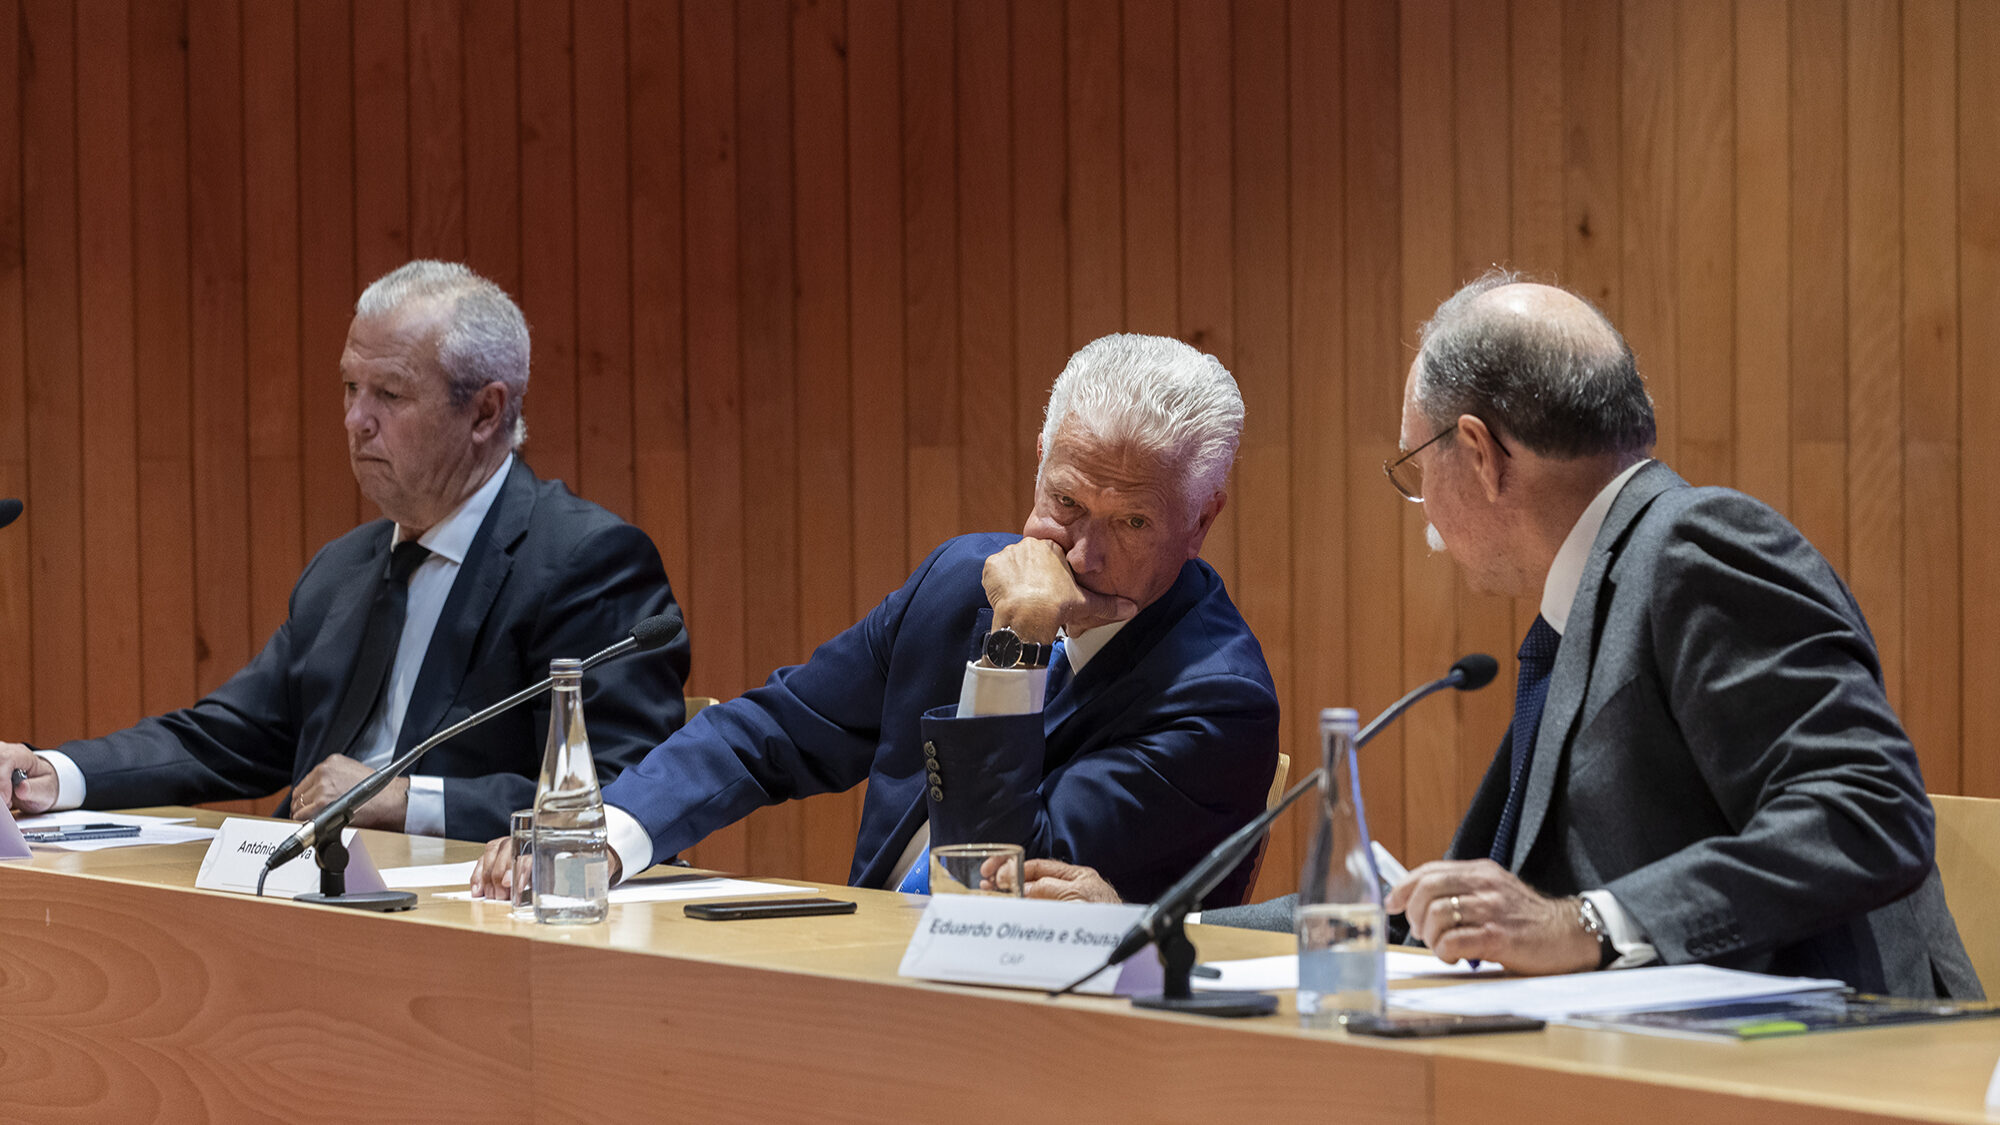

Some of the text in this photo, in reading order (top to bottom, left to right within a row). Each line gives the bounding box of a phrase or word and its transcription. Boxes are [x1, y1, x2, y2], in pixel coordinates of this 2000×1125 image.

[236, 840, 276, 856] António
[928, 918, 1121, 948] Eduardo Oliveira e Sousa
